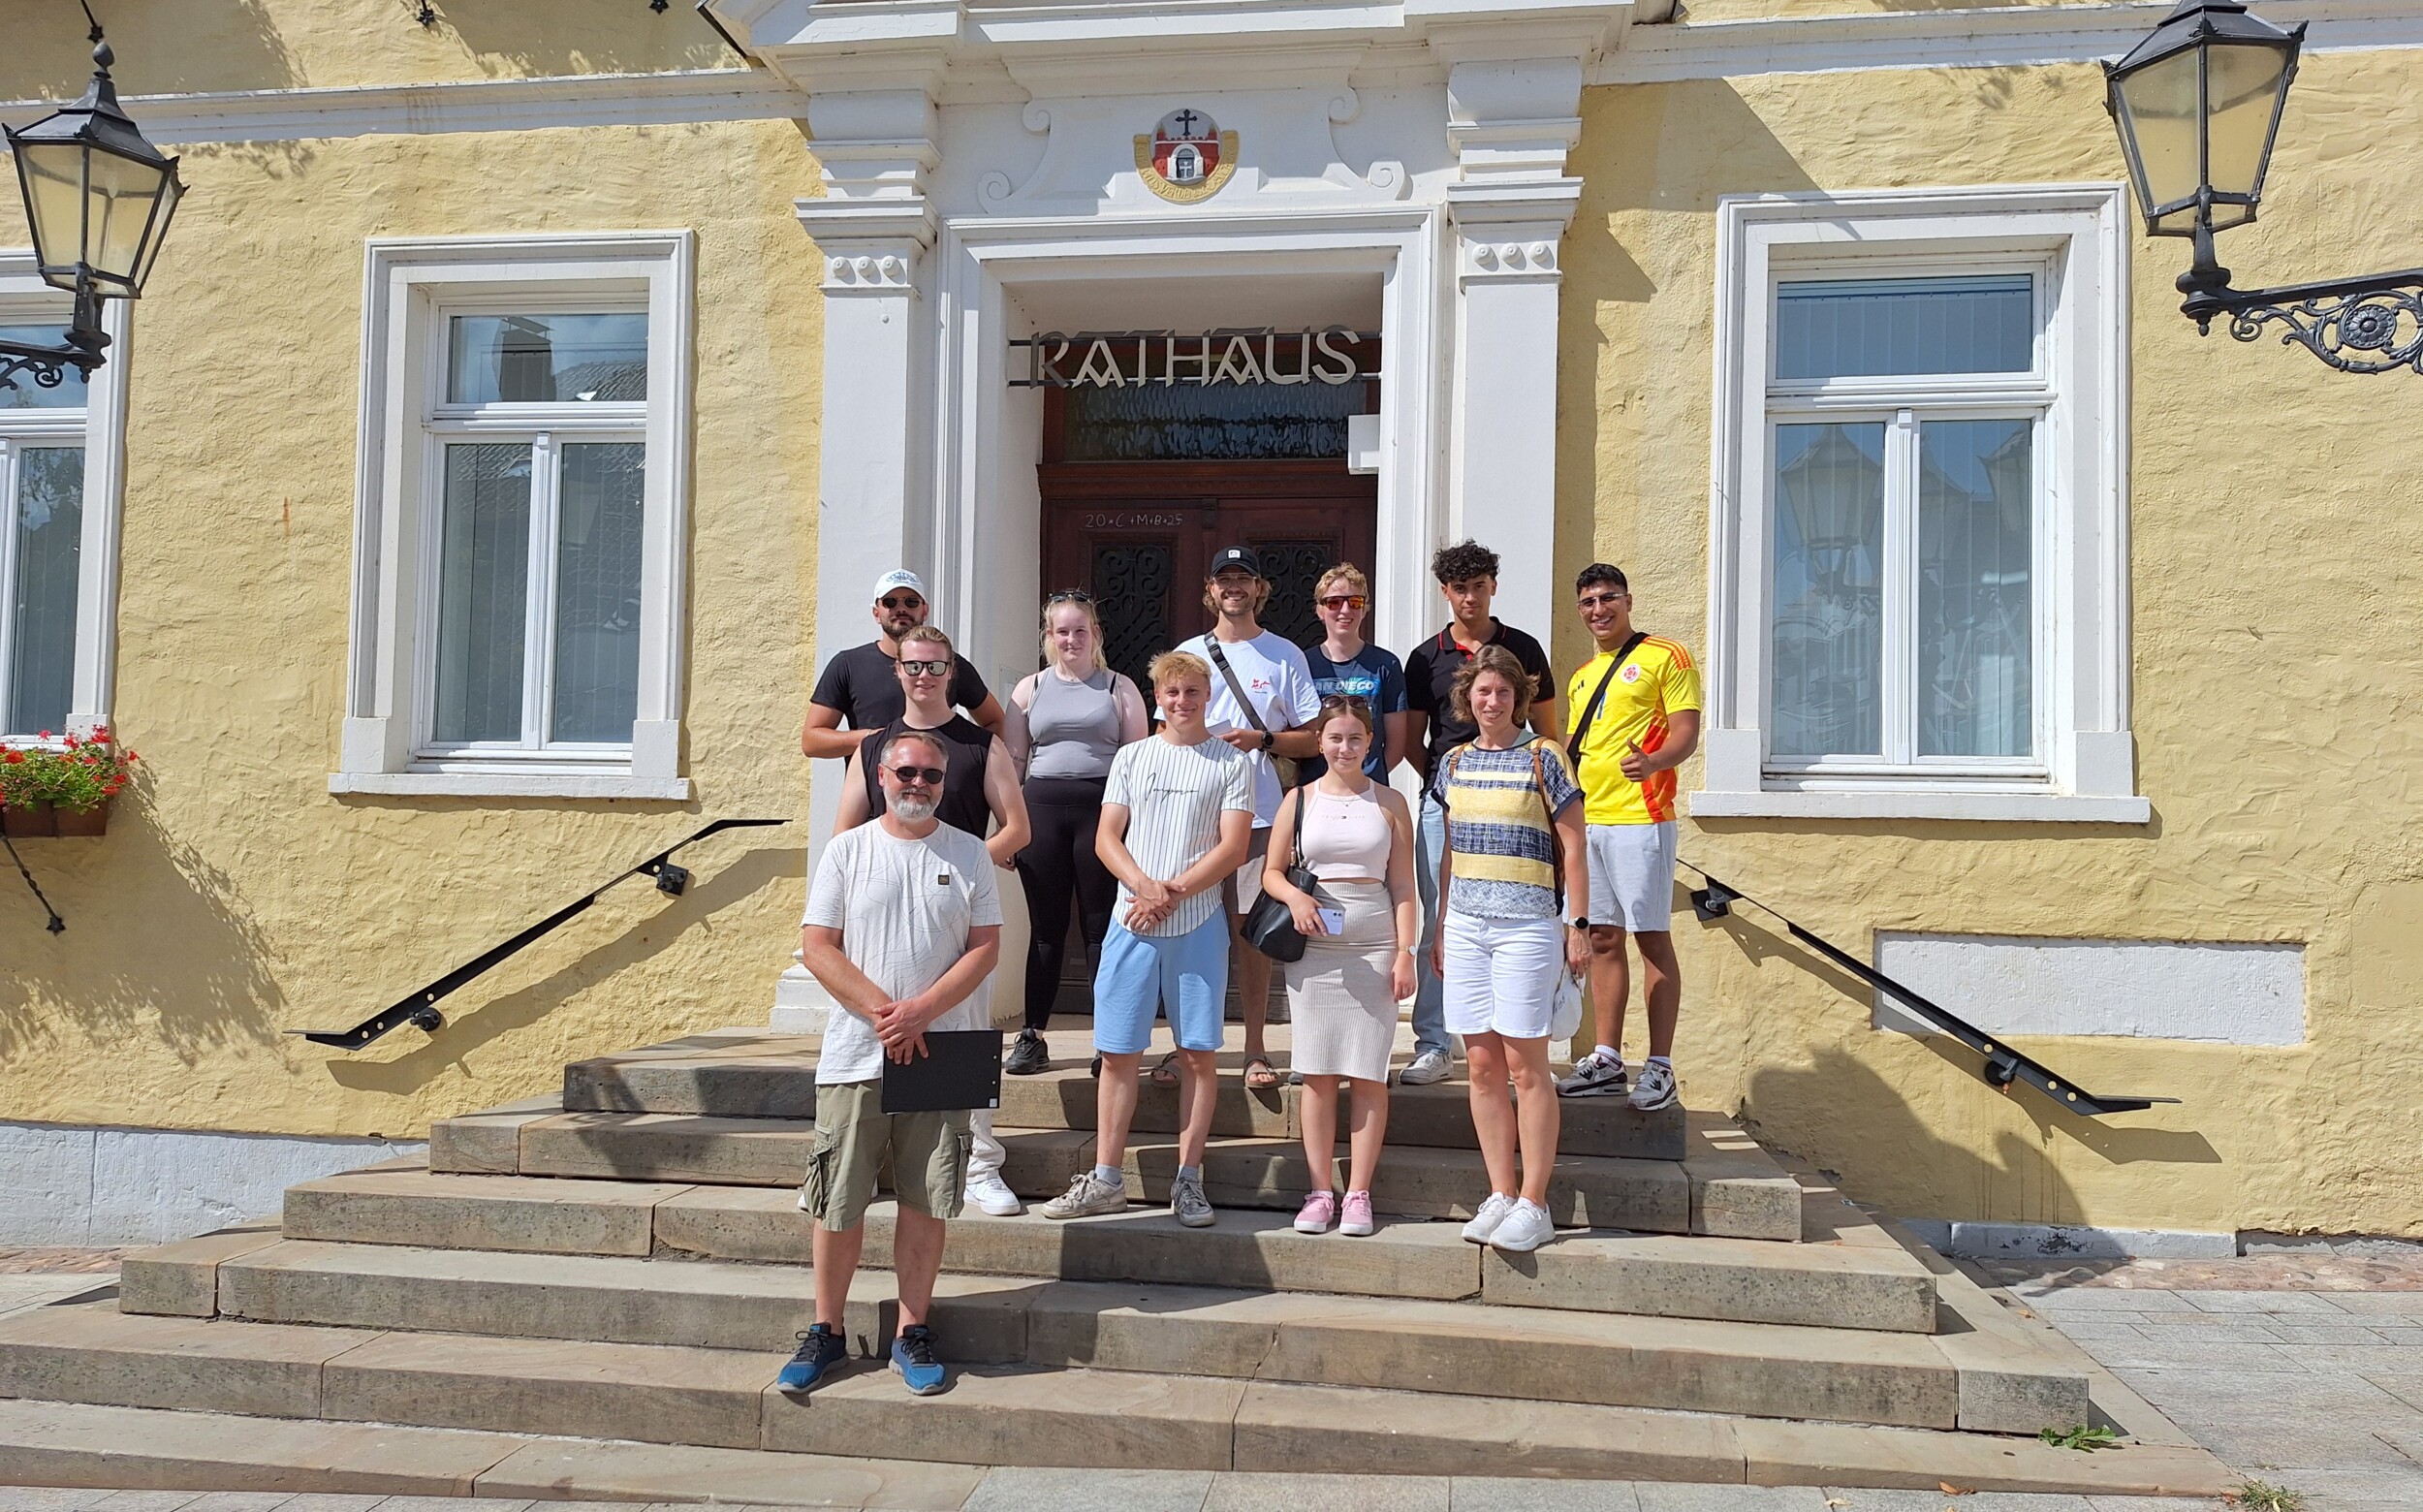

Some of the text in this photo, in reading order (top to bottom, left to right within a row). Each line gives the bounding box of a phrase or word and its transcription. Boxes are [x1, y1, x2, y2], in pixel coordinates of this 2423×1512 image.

[1030, 325, 1362, 389] RATHAUS
[1314, 679, 1374, 692] AN DIEGO
